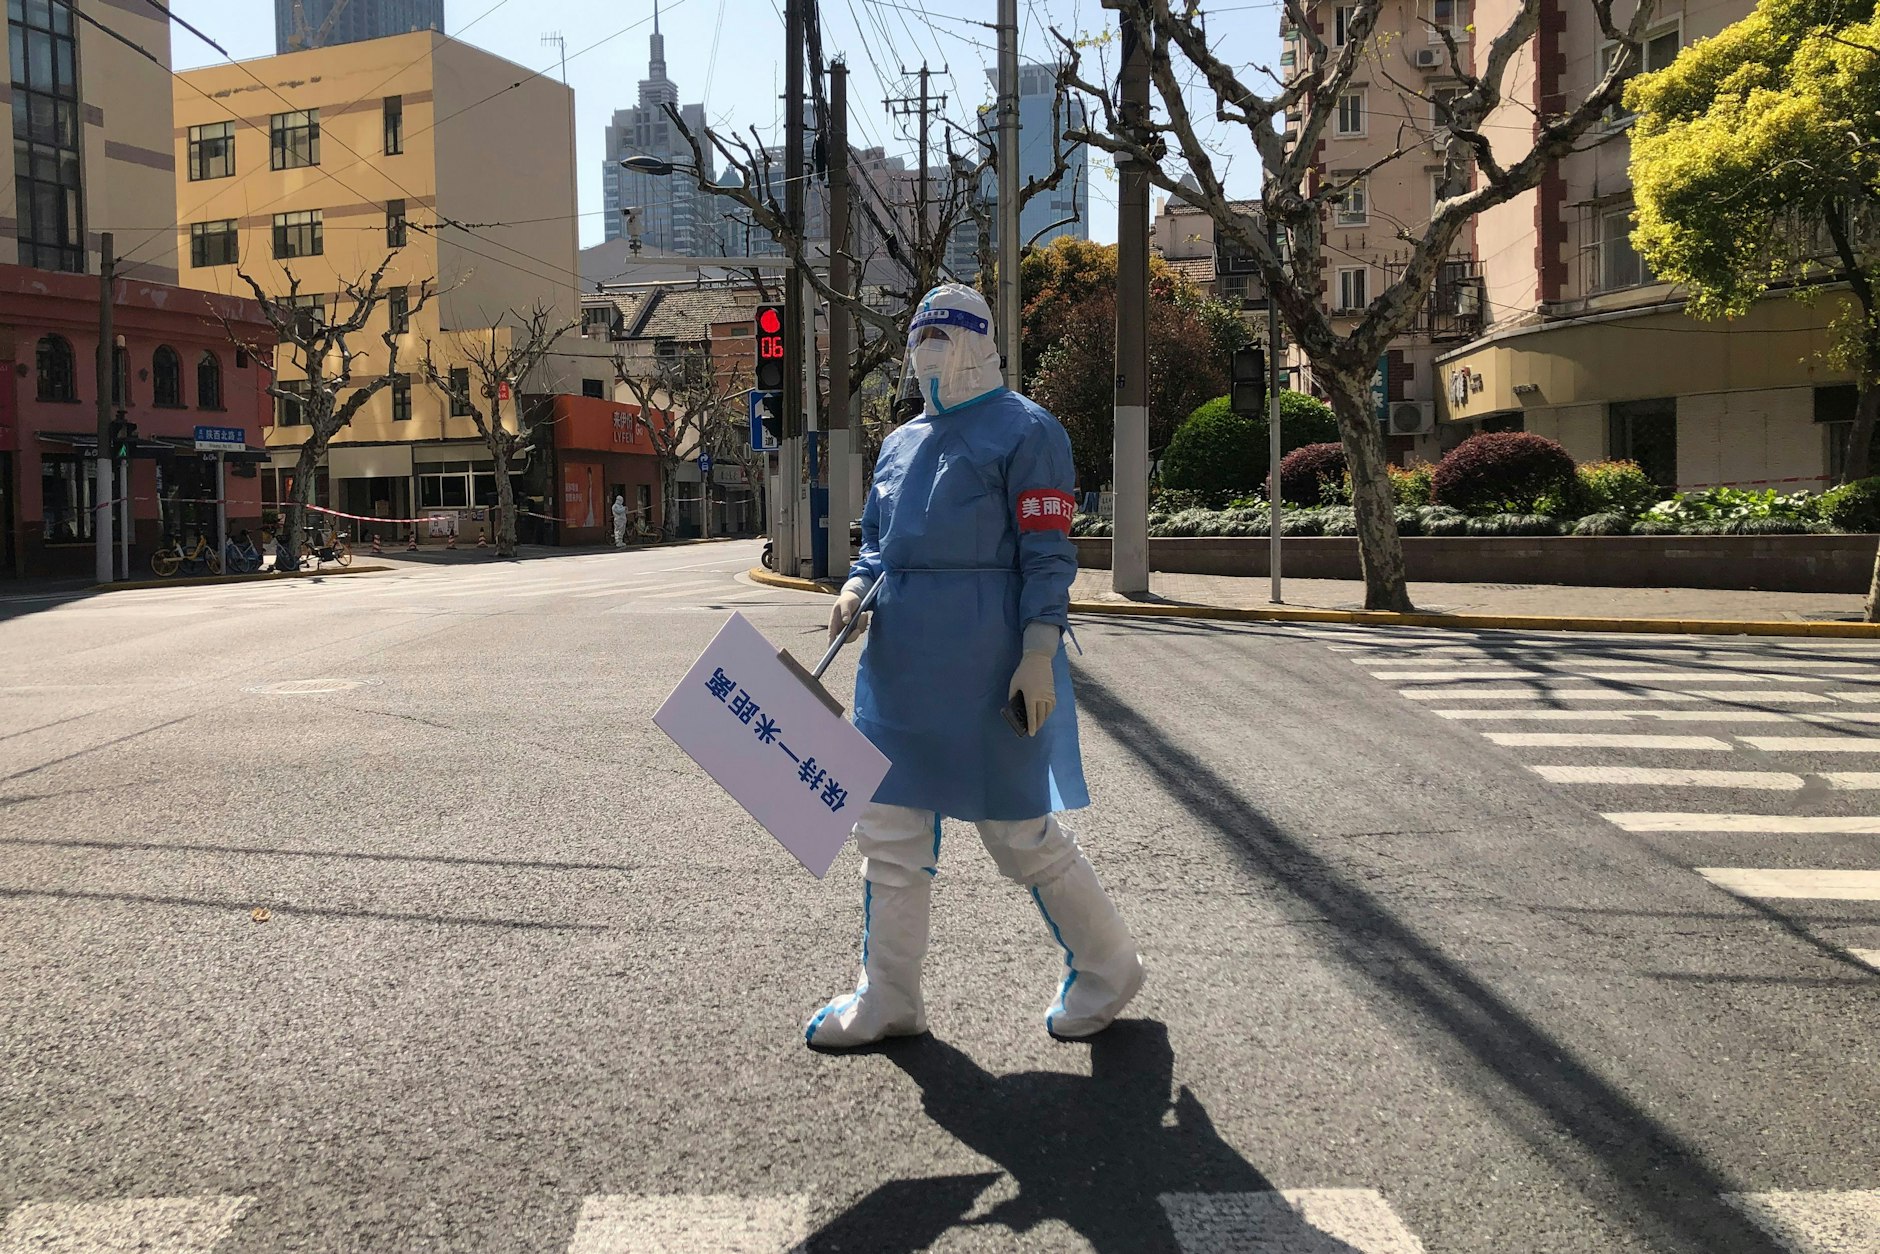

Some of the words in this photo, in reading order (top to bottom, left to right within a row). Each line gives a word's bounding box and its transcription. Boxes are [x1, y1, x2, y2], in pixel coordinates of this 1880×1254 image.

[761, 336, 784, 358] 06
[613, 411, 633, 430] 来伊份
[205, 429, 235, 441] 陕西北路
[613, 431, 634, 444] LYFEN
[704, 667, 848, 813] 保持一米距离
